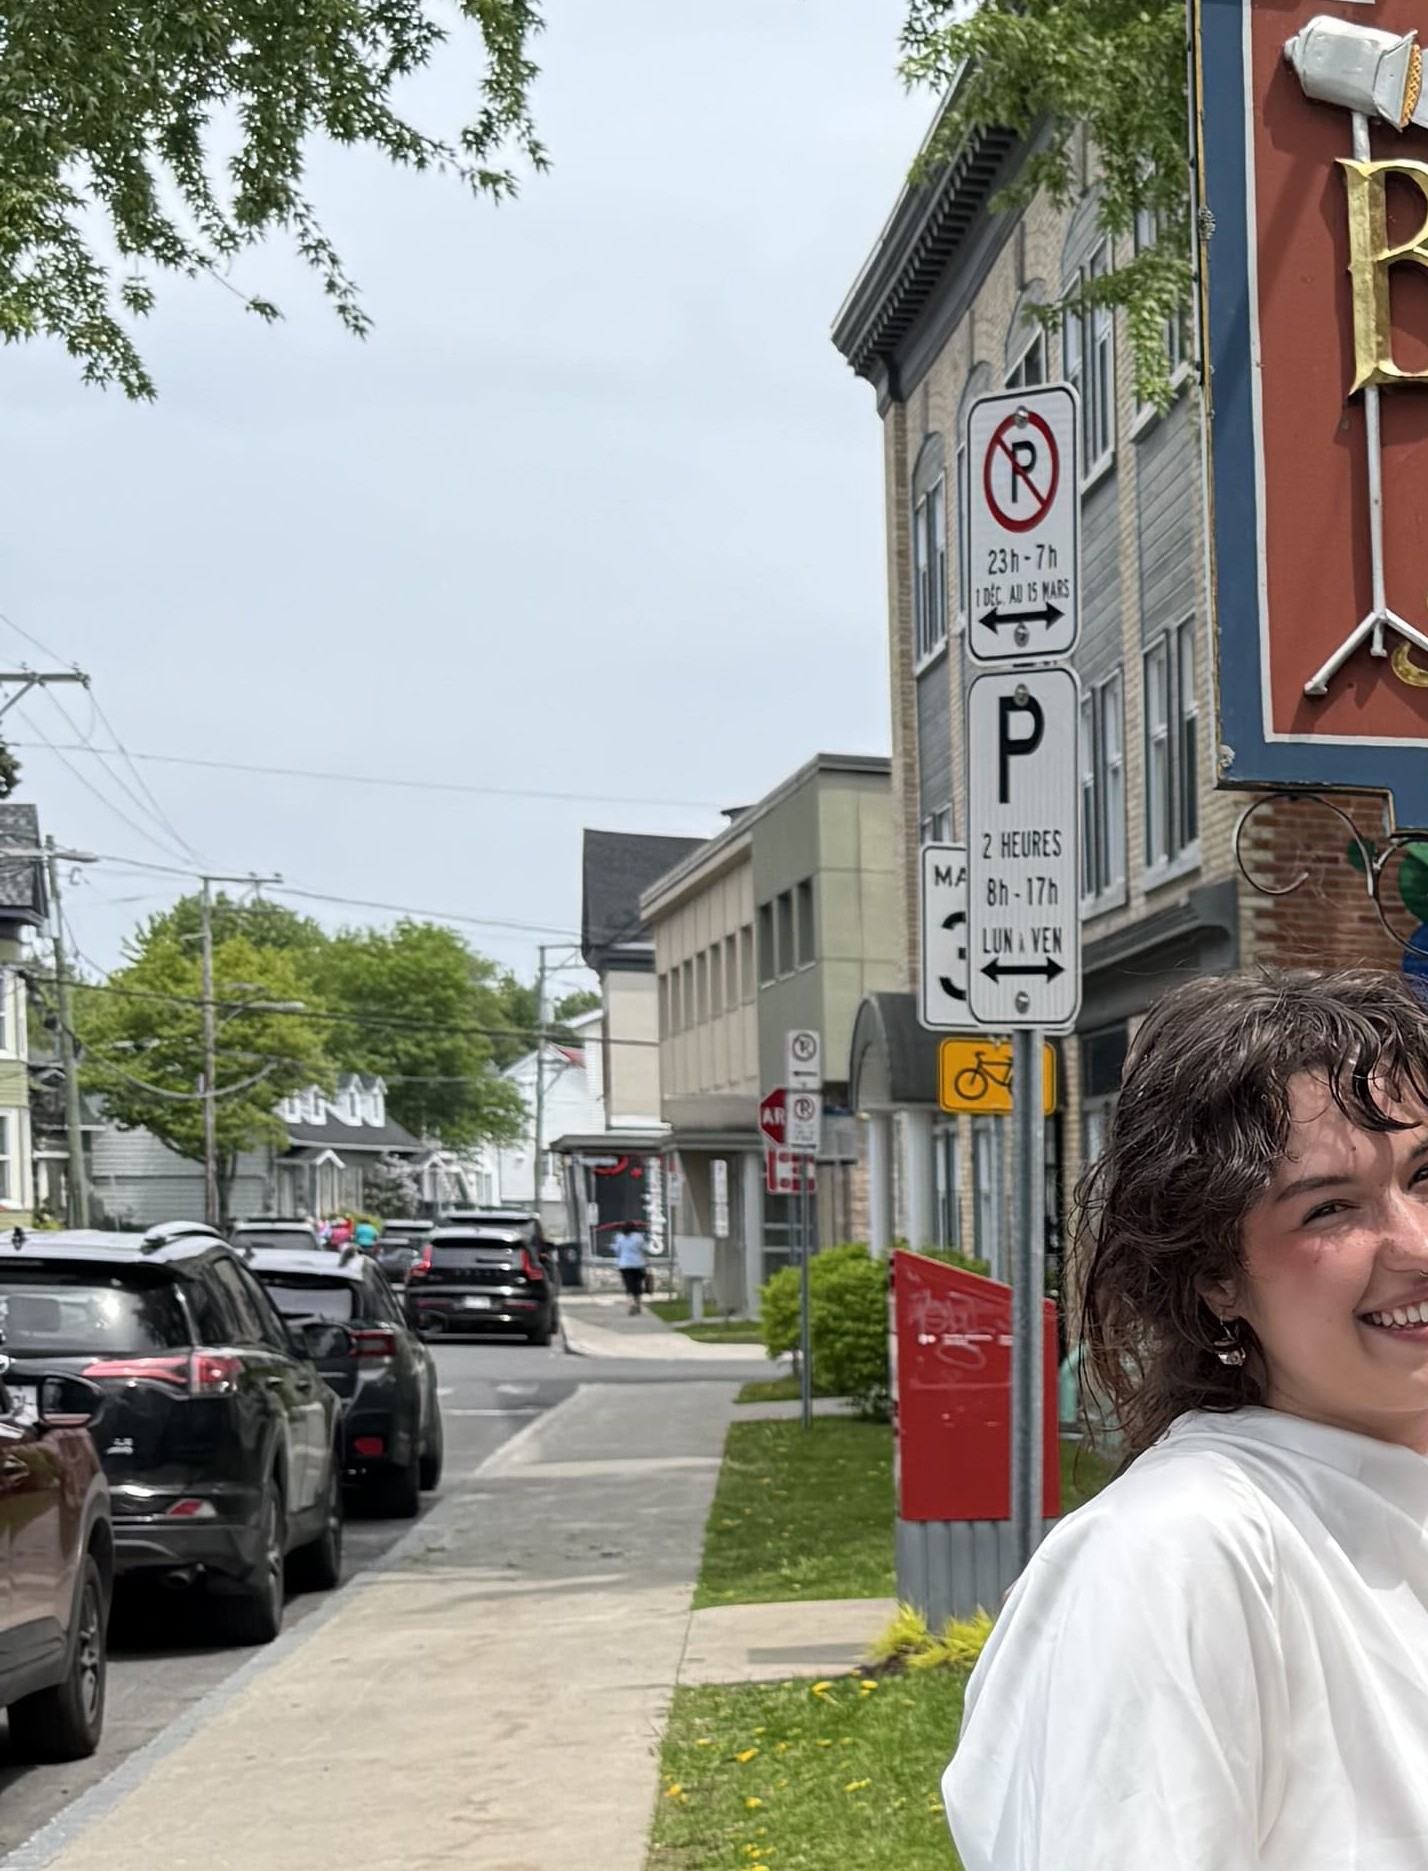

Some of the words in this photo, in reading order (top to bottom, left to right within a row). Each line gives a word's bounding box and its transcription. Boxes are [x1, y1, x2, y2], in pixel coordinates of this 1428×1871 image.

[1009, 583, 1023, 605] AU
[1042, 577, 1070, 603] MARS
[998, 695, 1045, 804] P
[983, 832, 992, 860] 2
[1001, 829, 1062, 859] HEURES
[934, 864, 967, 887] MA
[987, 877, 1008, 907] 8h
[1026, 876, 1058, 906] 17h
[983, 927, 1012, 954] LUN
[1031, 926, 1062, 954] VEN
[762, 1106, 786, 1127] AR
